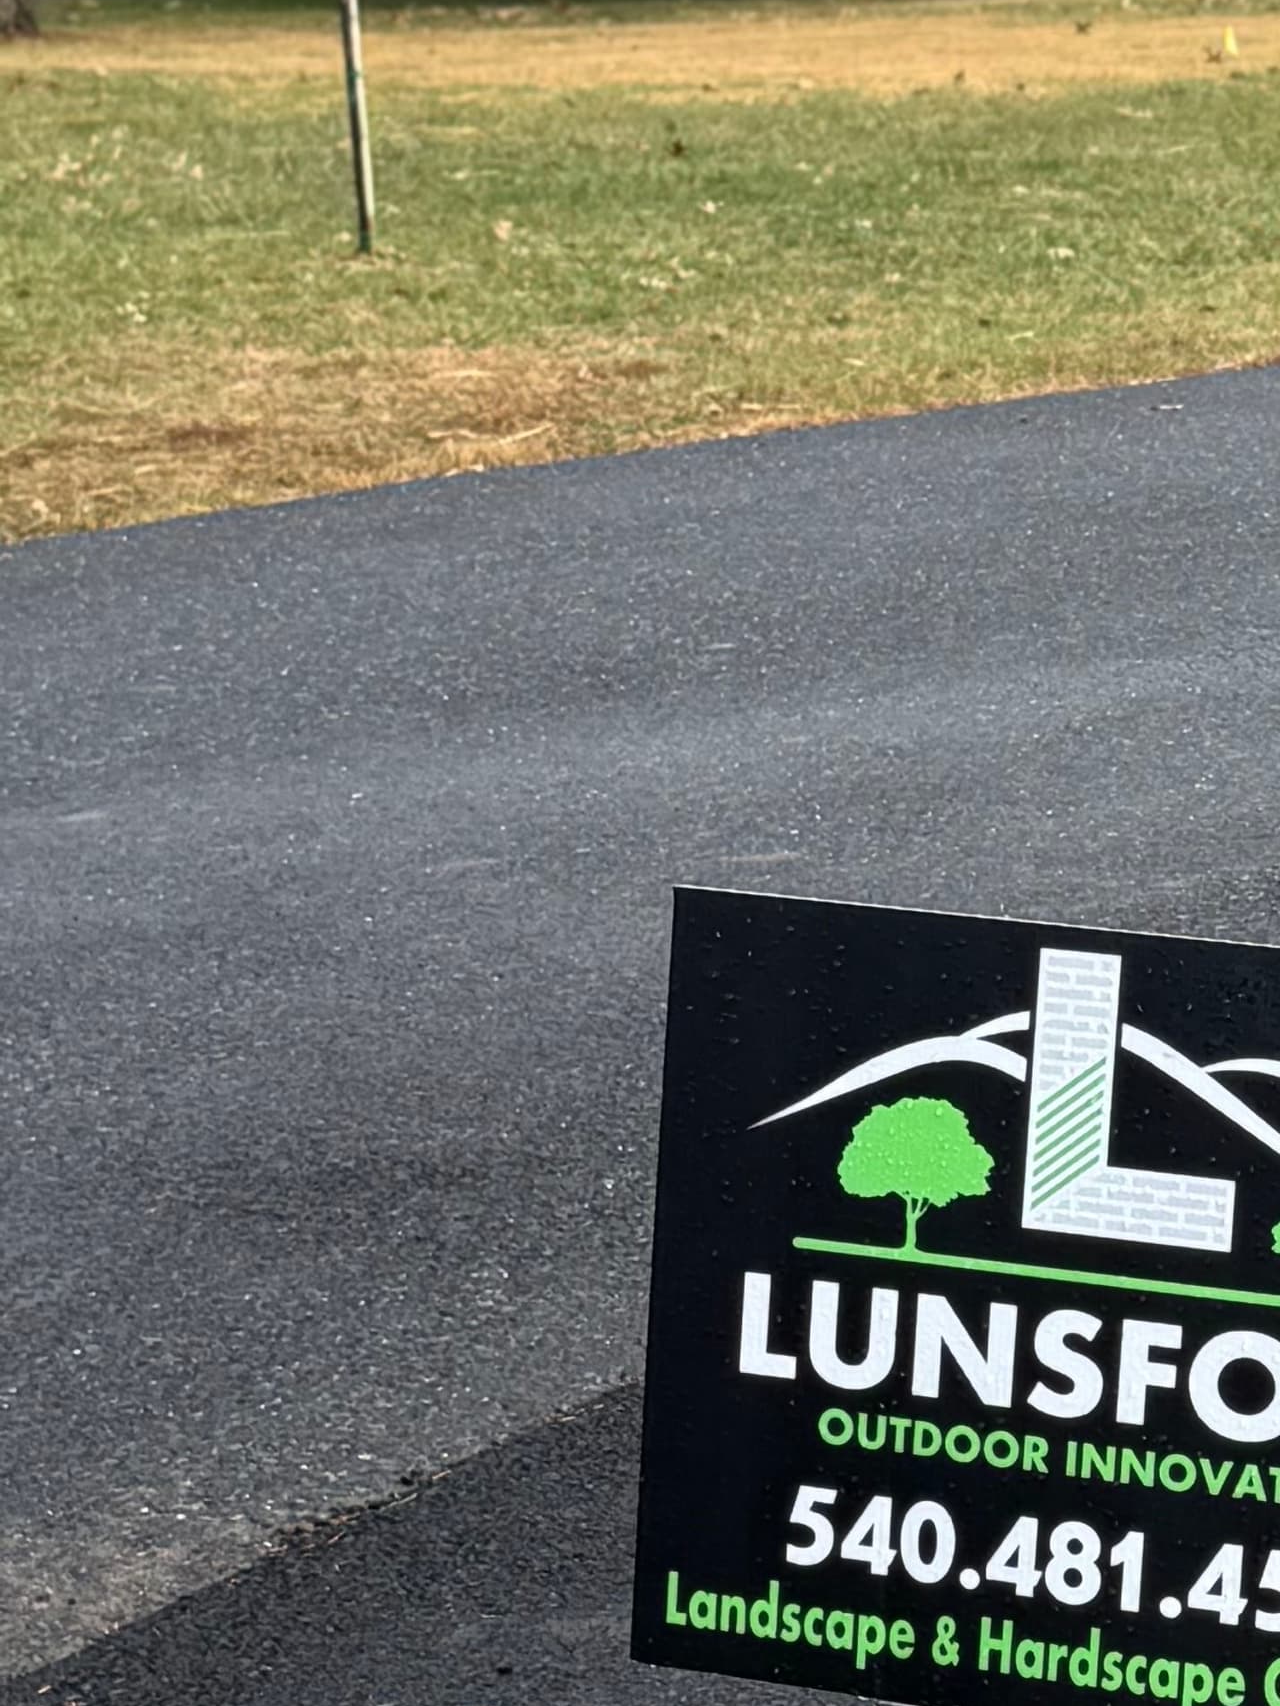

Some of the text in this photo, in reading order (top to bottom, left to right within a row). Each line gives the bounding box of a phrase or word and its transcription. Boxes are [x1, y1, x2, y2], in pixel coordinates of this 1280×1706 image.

[816, 1406, 1049, 1475] OUTDOOR
[665, 1569, 915, 1671] Landscape
[931, 1614, 960, 1667] &
